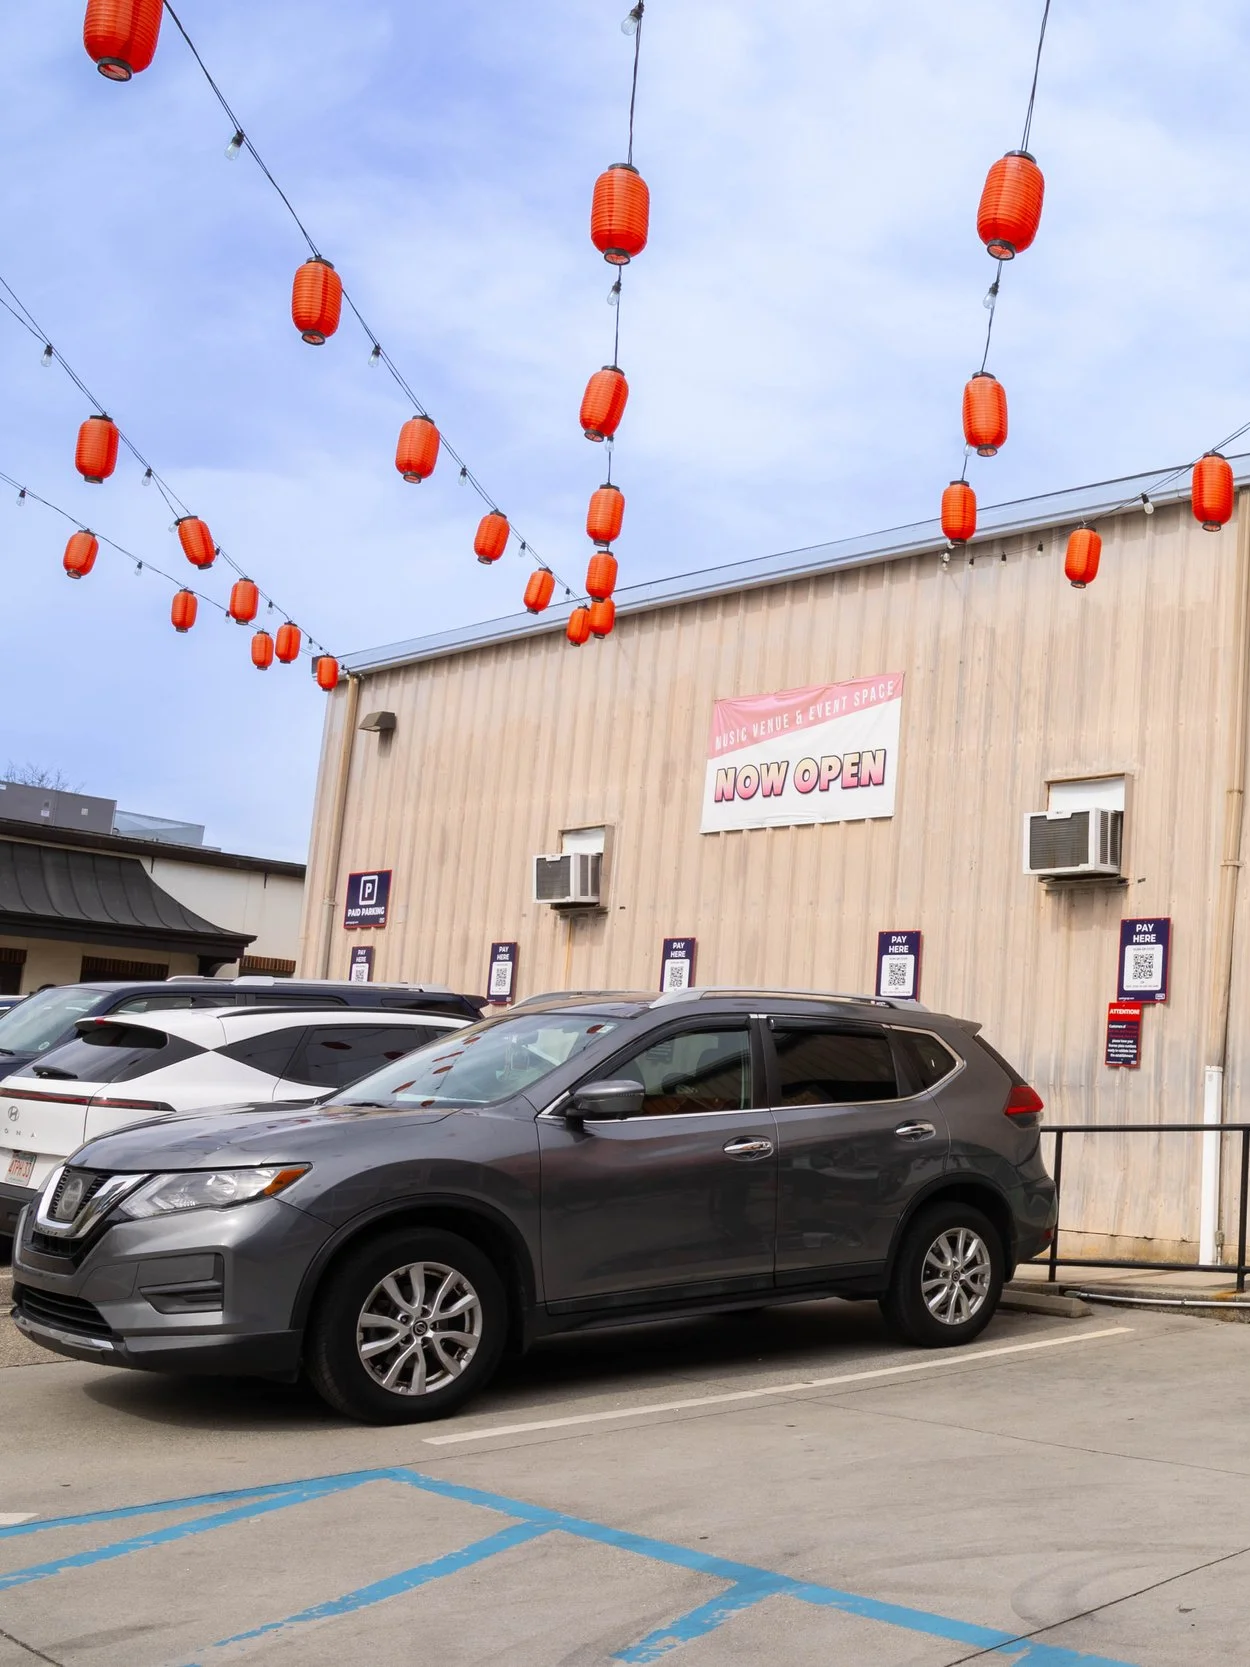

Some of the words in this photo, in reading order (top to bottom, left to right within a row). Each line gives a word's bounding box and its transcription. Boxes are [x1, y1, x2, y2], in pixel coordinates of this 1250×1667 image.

[715, 726, 748, 750] MUSIC
[752, 713, 790, 737] VENUE
[795, 711, 803, 725] &
[808, 696, 848, 721] EVENT
[853, 680, 894, 707] SPACE
[714, 760, 790, 803] NOW
[793, 748, 887, 795] OPEN
[364, 883, 373, 898] P
[347, 908, 361, 917] PAID
[361, 906, 385, 916] PARKING
[1136, 924, 1154, 932] PAY
[1133, 934, 1156, 943] HERE
[889, 945, 909, 953] HERE
